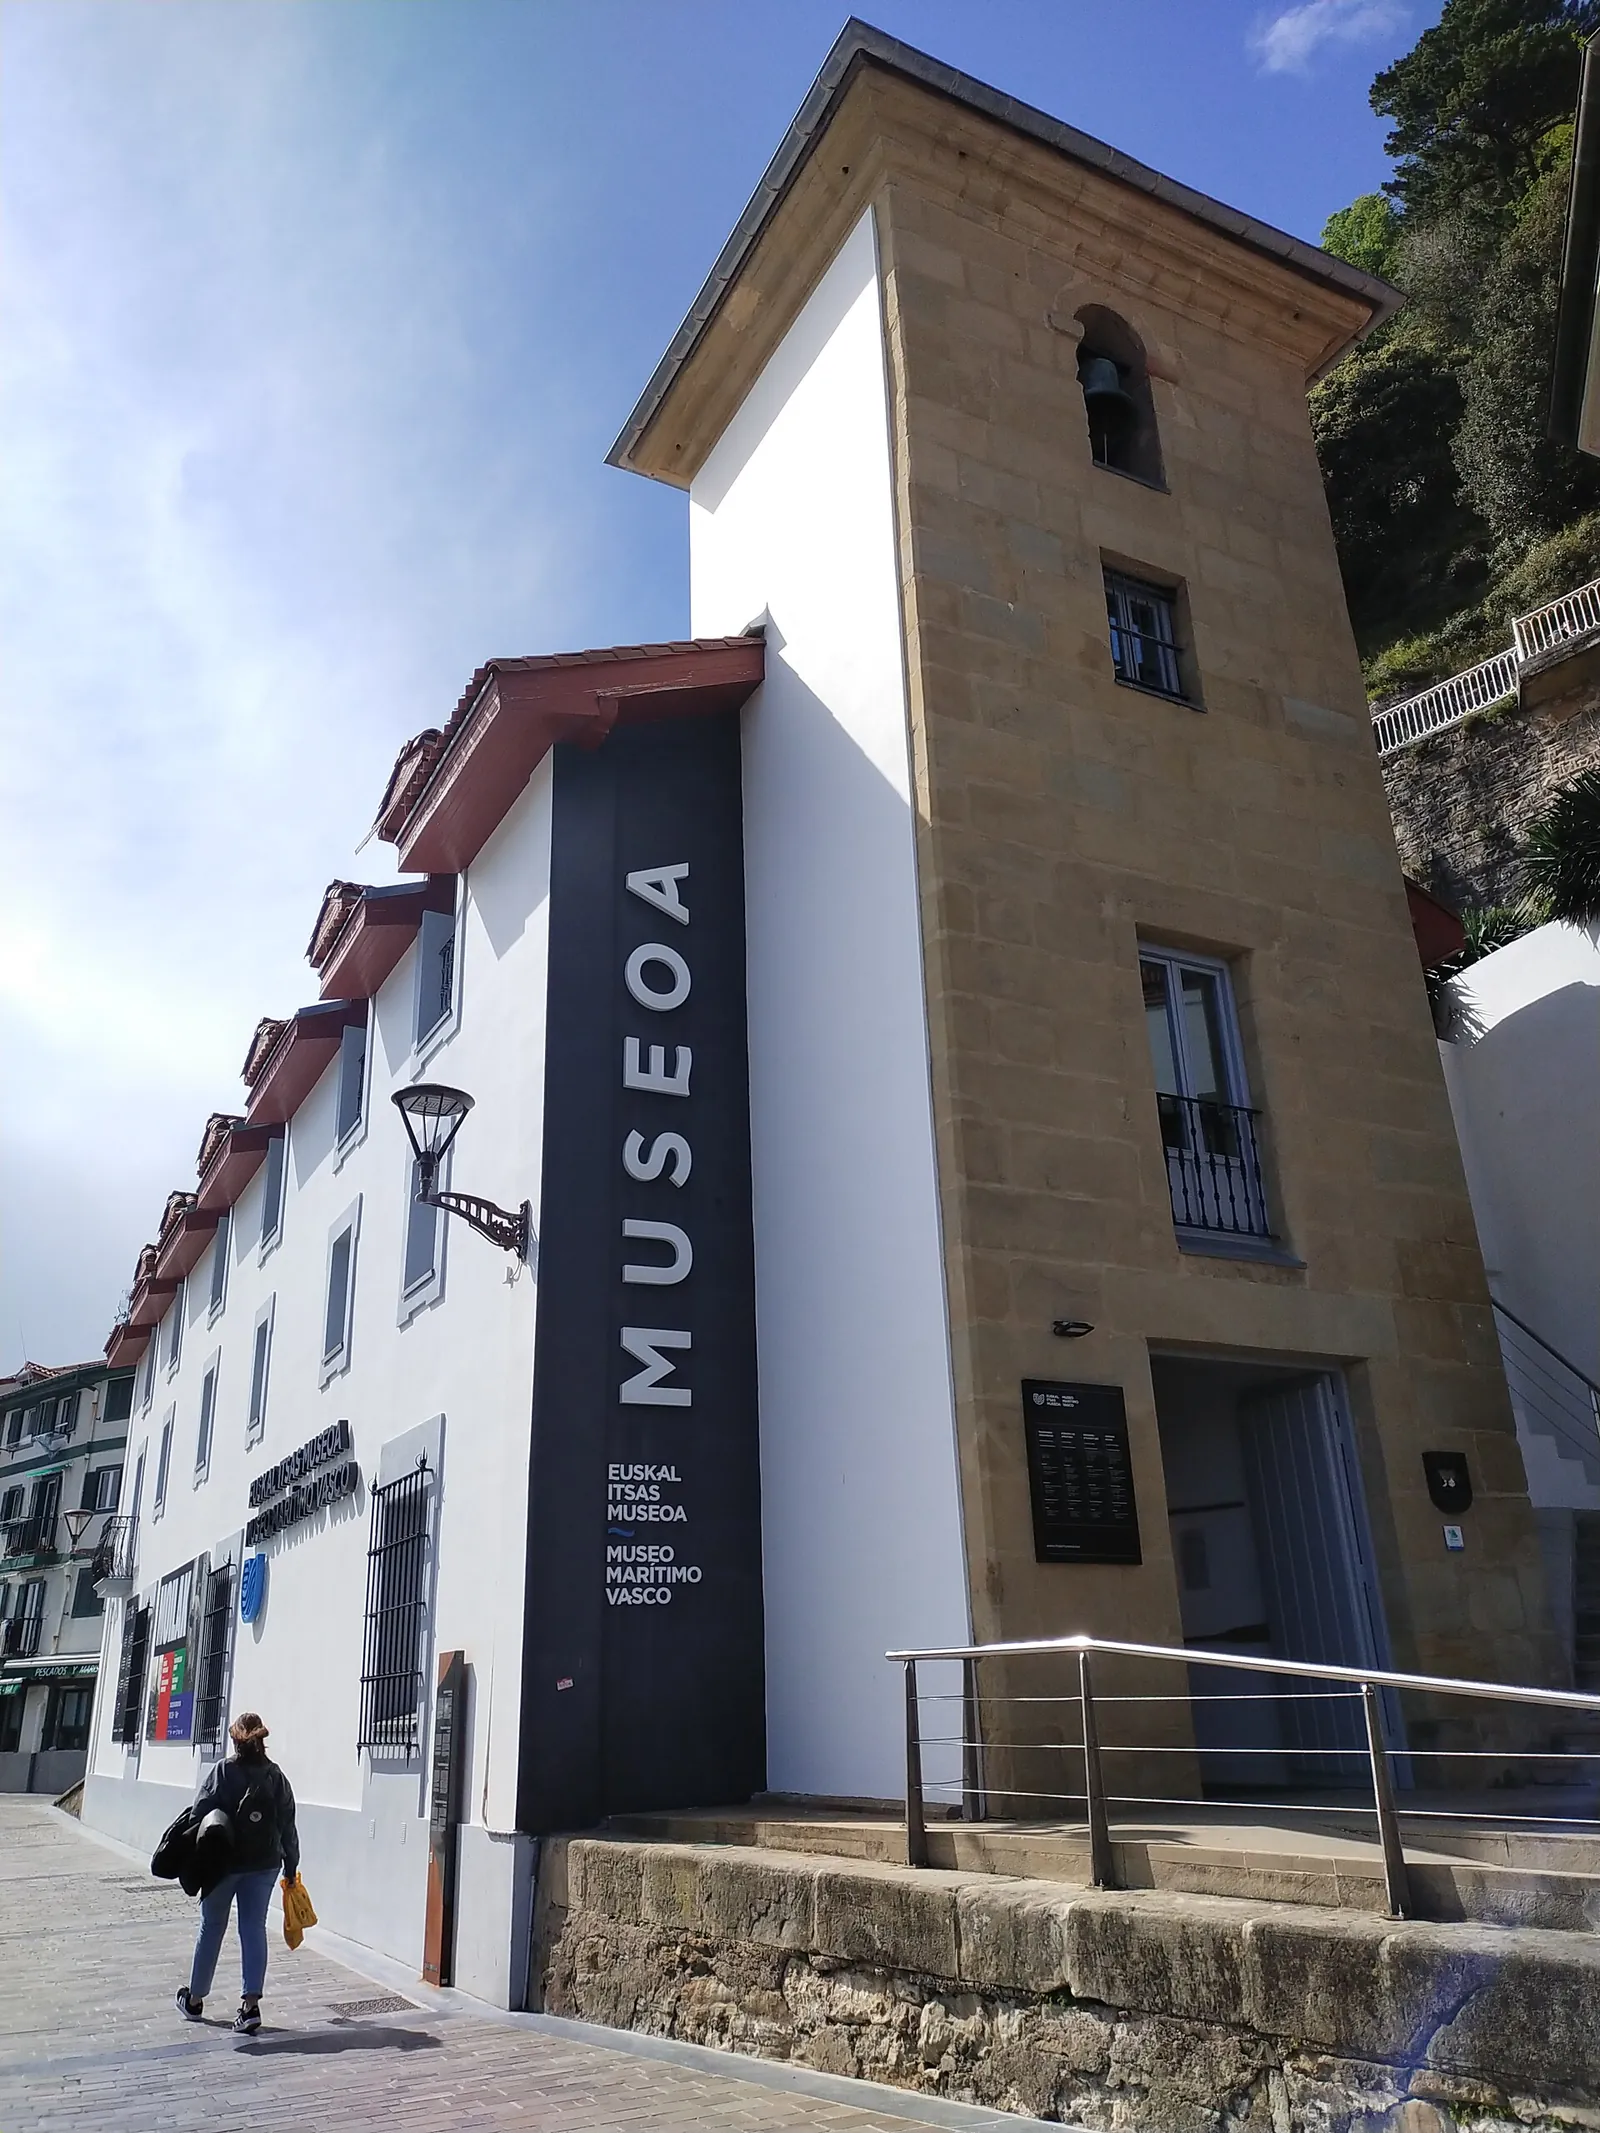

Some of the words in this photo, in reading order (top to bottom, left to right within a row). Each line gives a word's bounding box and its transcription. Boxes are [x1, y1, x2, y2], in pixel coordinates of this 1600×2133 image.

[619, 862, 693, 1407] MUSEOA
[301, 1420, 348, 1475] MUSEOA
[607, 1463, 682, 1482] EUSKAL
[317, 1461, 358, 1507] VASCO
[607, 1483, 661, 1501] ITSAS
[607, 1504, 688, 1522] MUSEOA
[606, 1545, 675, 1563] MUSEO
[606, 1562, 702, 1584] MARÍTIMO
[605, 1587, 672, 1605] VASCO
[35, 1666, 68, 1677] PESCADOS
[72, 1665, 79, 1675] Y
